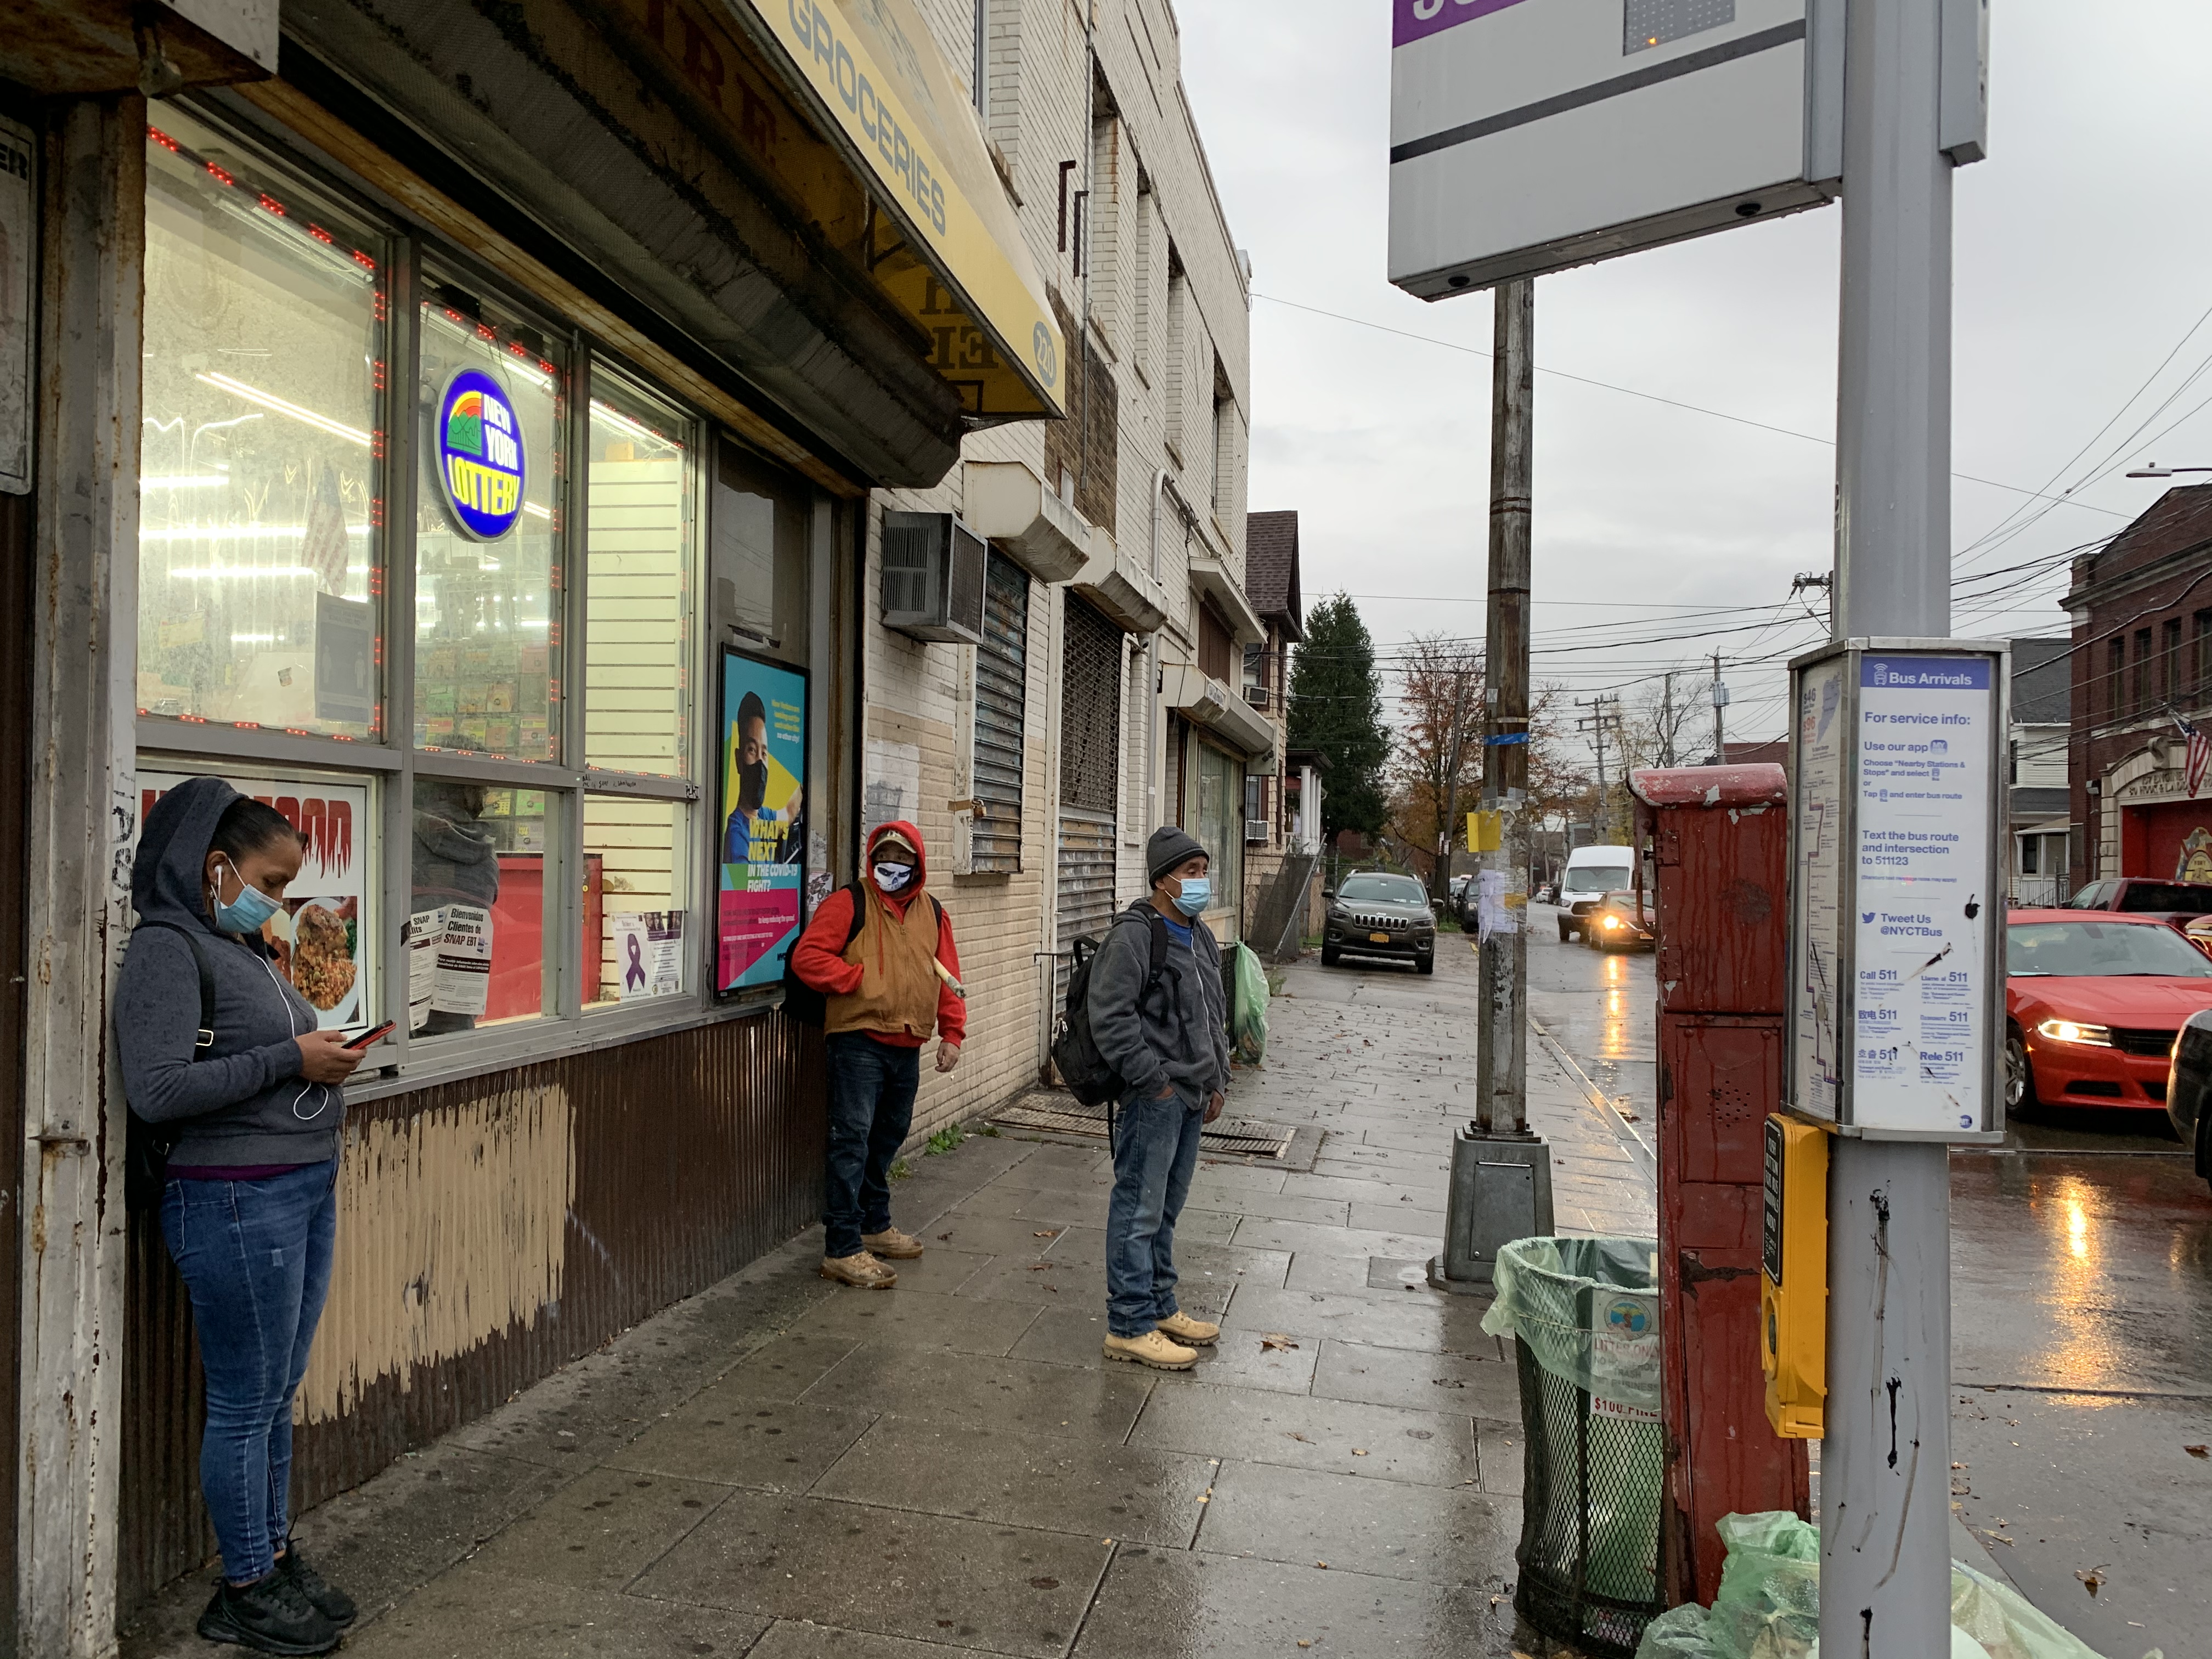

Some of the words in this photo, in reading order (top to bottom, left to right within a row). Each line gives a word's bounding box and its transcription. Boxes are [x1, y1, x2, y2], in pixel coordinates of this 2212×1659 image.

[788, 0, 945, 236] GROCERIES
[1037, 329, 1053, 379] 220
[484, 393, 511, 435] NEW
[484, 424, 518, 471] YORK
[447, 454, 521, 516] LOTTERY
[1889, 673, 1916, 684] Bus
[1919, 673, 1972, 685] Arrivals
[1865, 712, 1887, 723] For
[1890, 714, 1938, 724] service
[1942, 714, 1970, 725] info:
[1864, 742, 1885, 751] Use
[1908, 744, 1928, 753] app
[1863, 830, 1886, 839] Text
[1888, 831, 1906, 840] the
[1908, 832, 1928, 840] bus
[1930, 833, 1959, 842] route
[748, 842, 777, 861] NEXT
[1862, 844, 1882, 852] and
[1884, 844, 1949, 854] intersection
[1862, 856, 1872, 865] to
[1875, 856, 1909, 866] 511123
[748, 864, 756, 877] IN
[757, 864, 770, 877] THE
[770, 864, 798, 877] COVID-19
[747, 879, 771, 893] FIGHT?
[413, 915, 430, 926] SNAP
[450, 908, 484, 922] Bienvenidos
[1881, 913, 1915, 923] Tweet
[1917, 915, 1931, 923] Us
[447, 921, 474, 933] Clientes
[475, 924, 482, 934] de
[1881, 926, 1943, 936] @NYCTBus
[443, 933, 466, 945] SNAP
[467, 936, 477, 946] EBT
[1860, 971, 1876, 979] Call
[1879, 970, 1897, 980] 511
[1949, 972, 1967, 982] 511
[1879, 1009, 1897, 1019] 511
[1949, 1011, 1967, 1022] 511
[1880, 1049, 1897, 1060] 511
[1920, 1052, 1943, 1061] Rele
[1945, 1051, 1963, 1062] 511
[1594, 1357, 1606, 1365] NO
[1615, 1369, 1641, 1379] TRASH
[1595, 1397, 1623, 1414] $100
